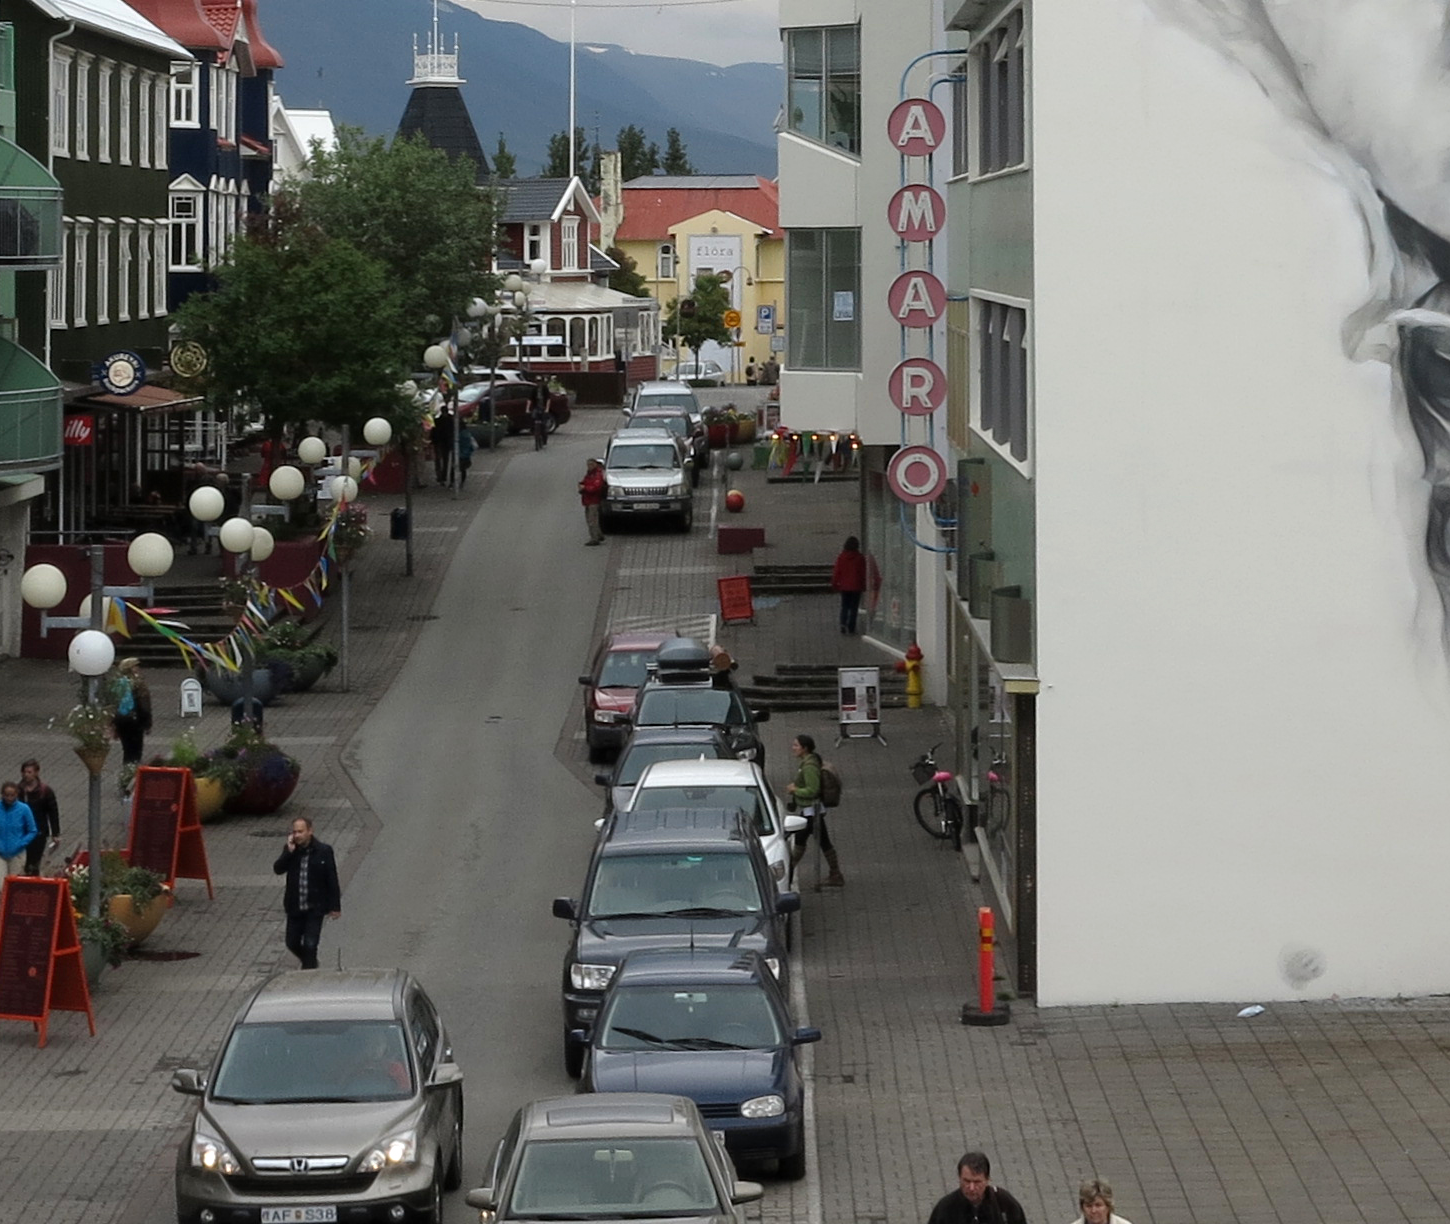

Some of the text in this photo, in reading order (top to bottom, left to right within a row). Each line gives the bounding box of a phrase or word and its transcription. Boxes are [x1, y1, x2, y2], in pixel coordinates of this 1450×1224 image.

[895, 104, 941, 496] AMARO
[64, 418, 91, 442] illy
[271, 1209, 292, 1222] AF
